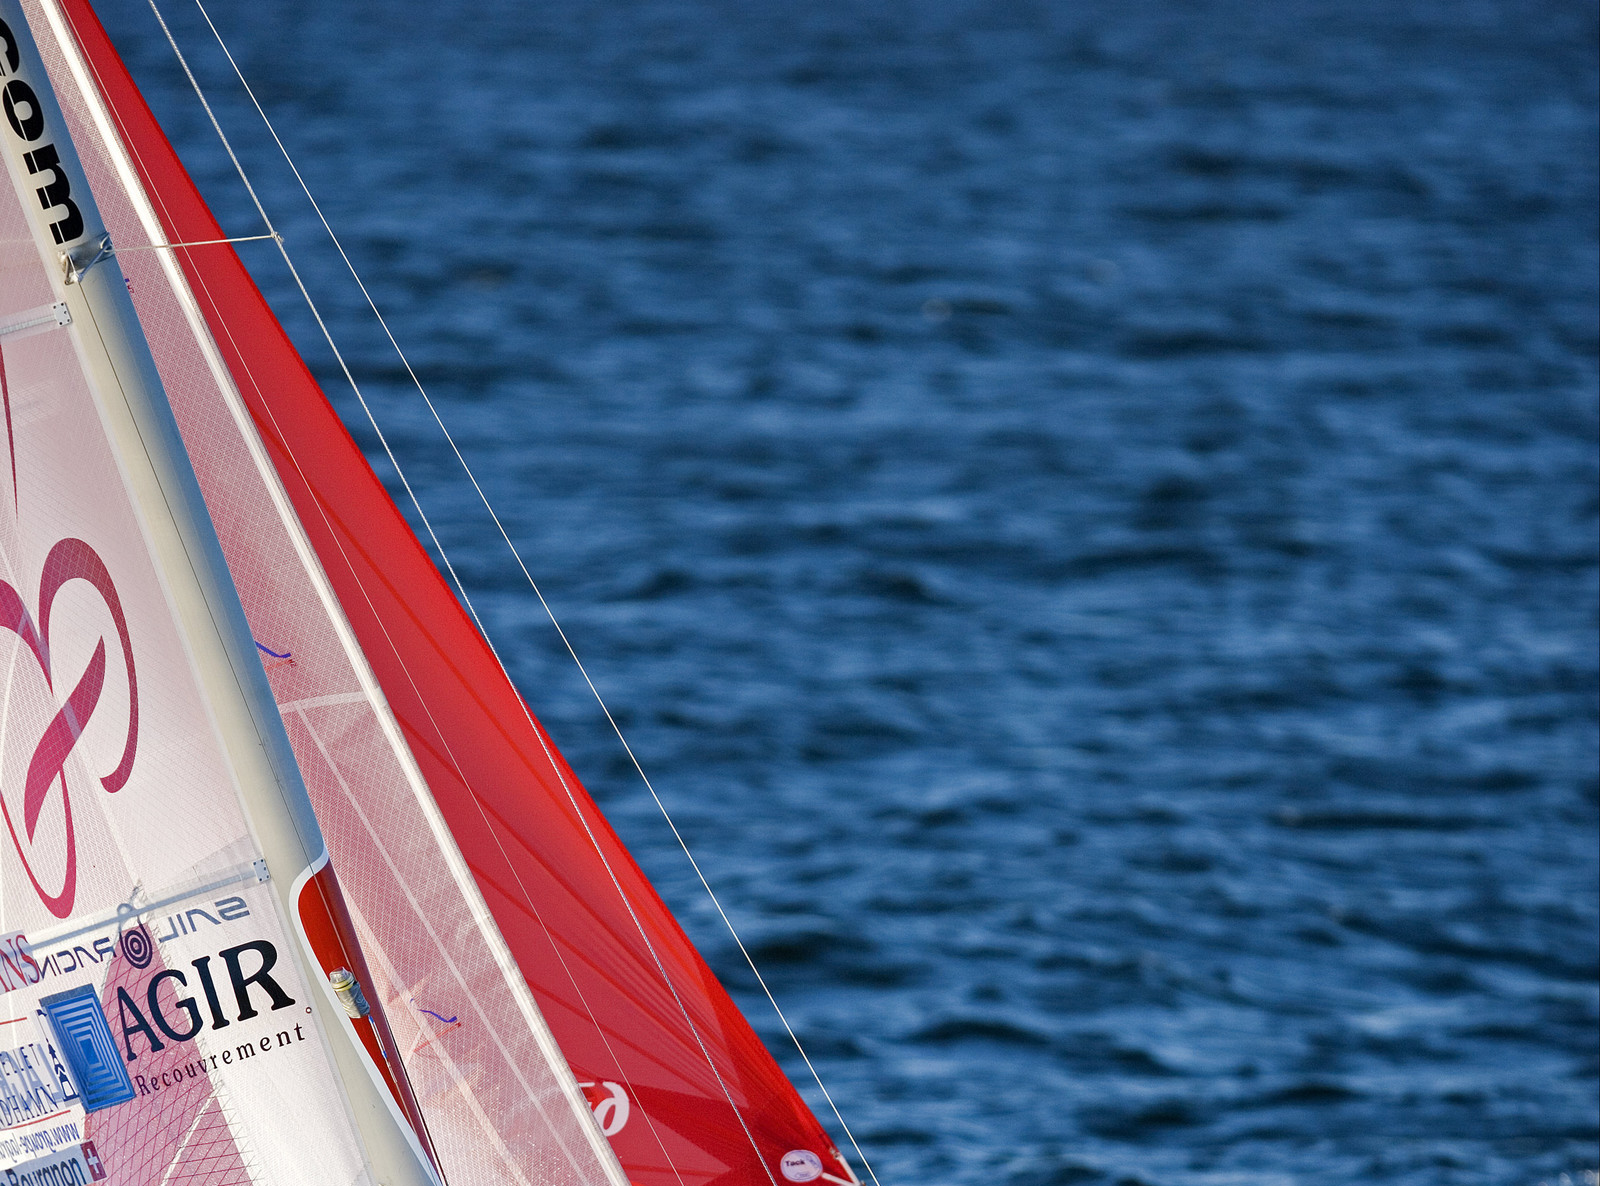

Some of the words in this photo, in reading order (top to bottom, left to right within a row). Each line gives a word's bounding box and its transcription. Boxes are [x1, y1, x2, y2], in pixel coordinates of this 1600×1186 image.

[117, 939, 296, 1062] AGIR
[135, 1023, 305, 1097] Recouvrement
[0, 1083, 59, 1127] DHAMN
